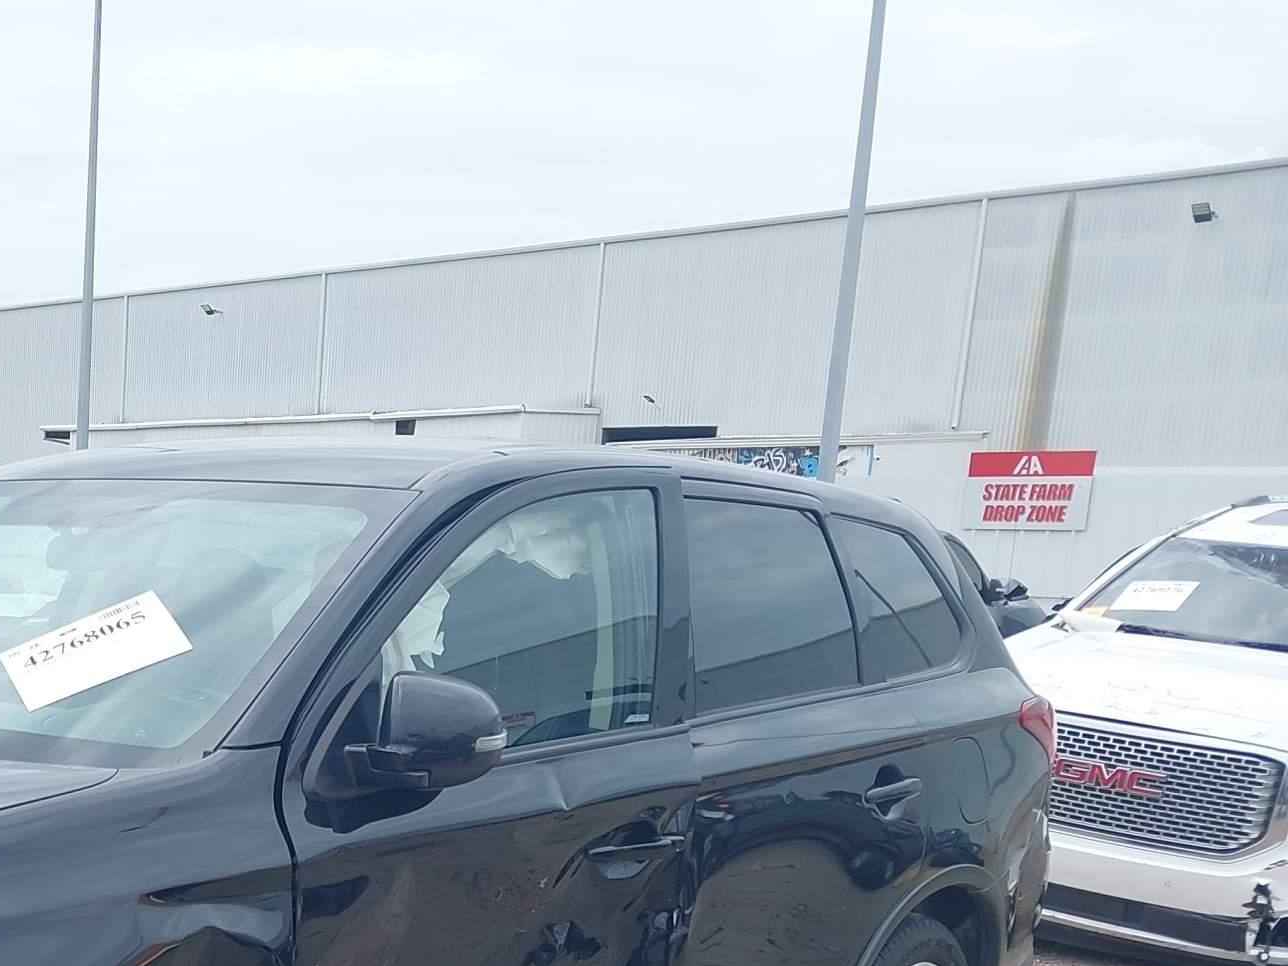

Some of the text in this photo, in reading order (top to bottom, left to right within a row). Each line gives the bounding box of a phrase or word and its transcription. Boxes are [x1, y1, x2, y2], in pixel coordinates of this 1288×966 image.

[982, 484, 1074, 501] STATE FARM
[982, 505, 1068, 523] DROP ZONE
[23, 611, 146, 668] 42768065
[1054, 757, 1167, 797] GMC
